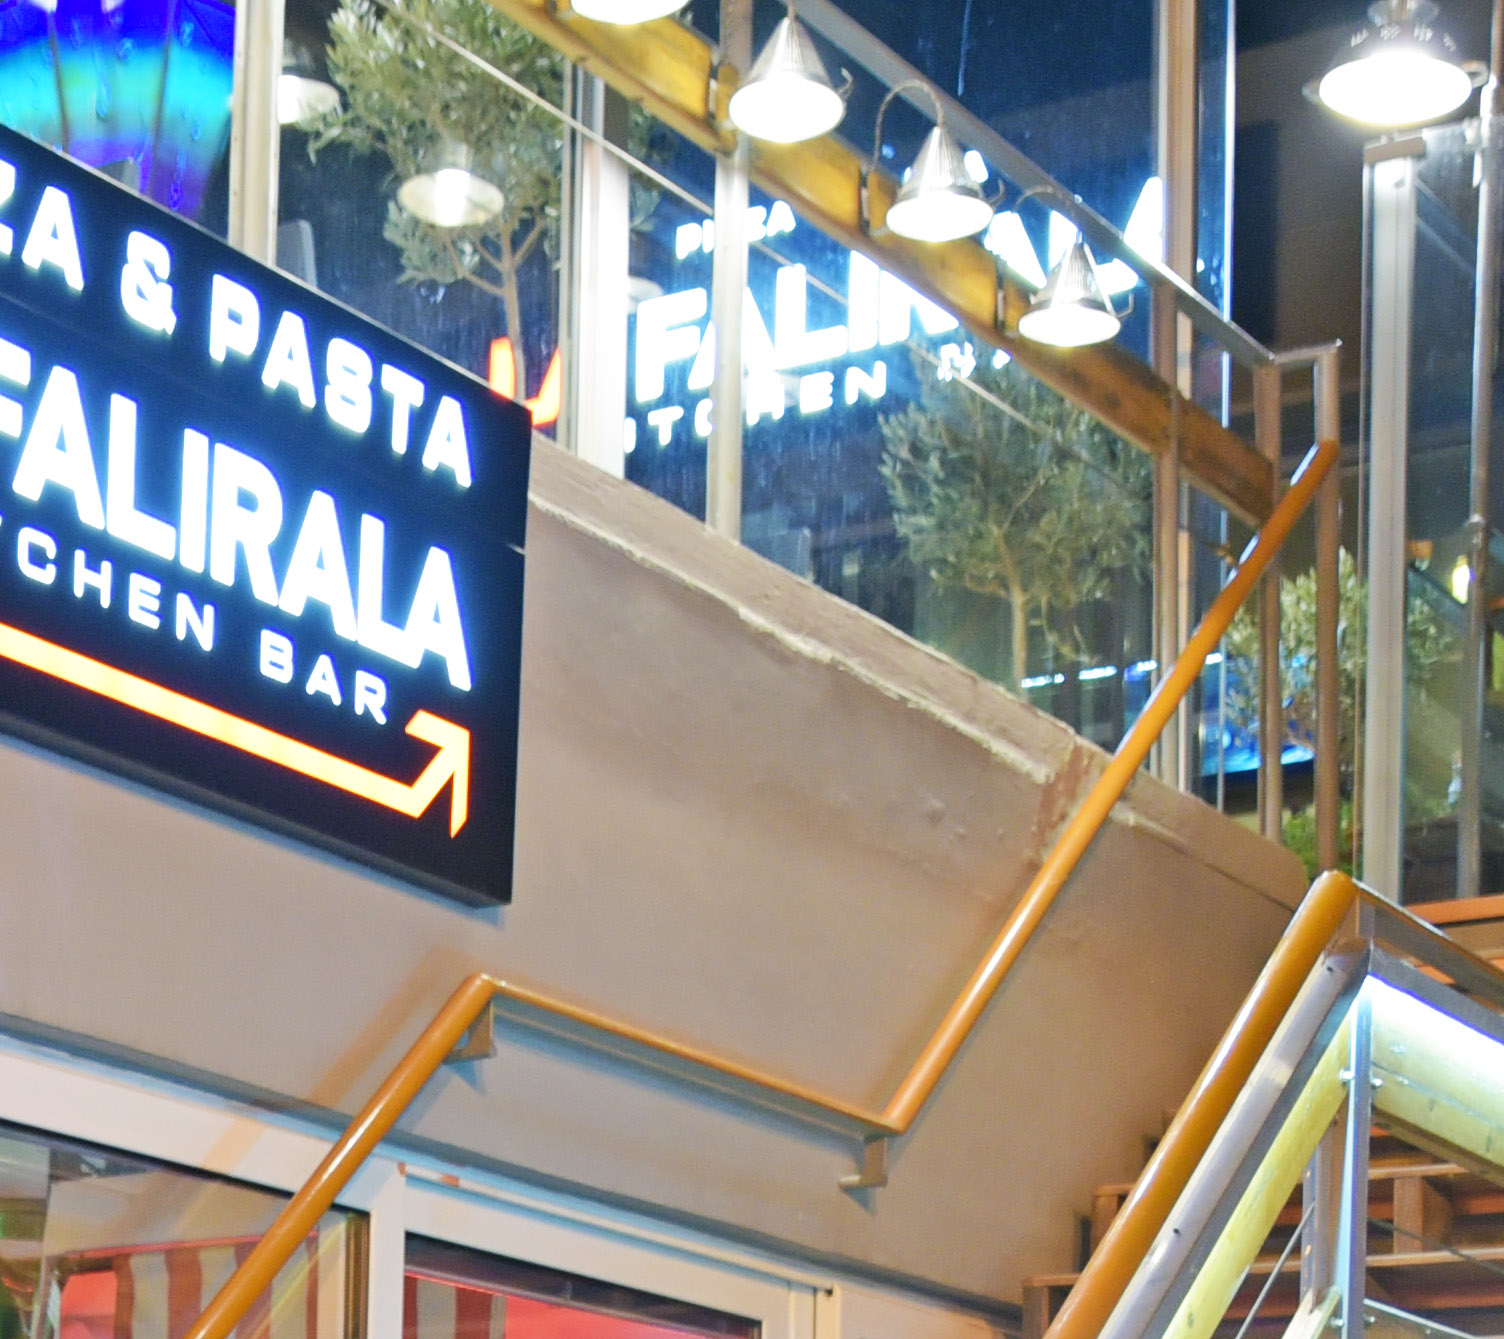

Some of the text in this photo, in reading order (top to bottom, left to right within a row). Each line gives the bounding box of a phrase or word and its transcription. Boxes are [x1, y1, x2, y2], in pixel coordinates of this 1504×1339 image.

[120, 230, 176, 334] &
[209, 274, 473, 488] PASTA
[259, 629, 388, 725] BAR
